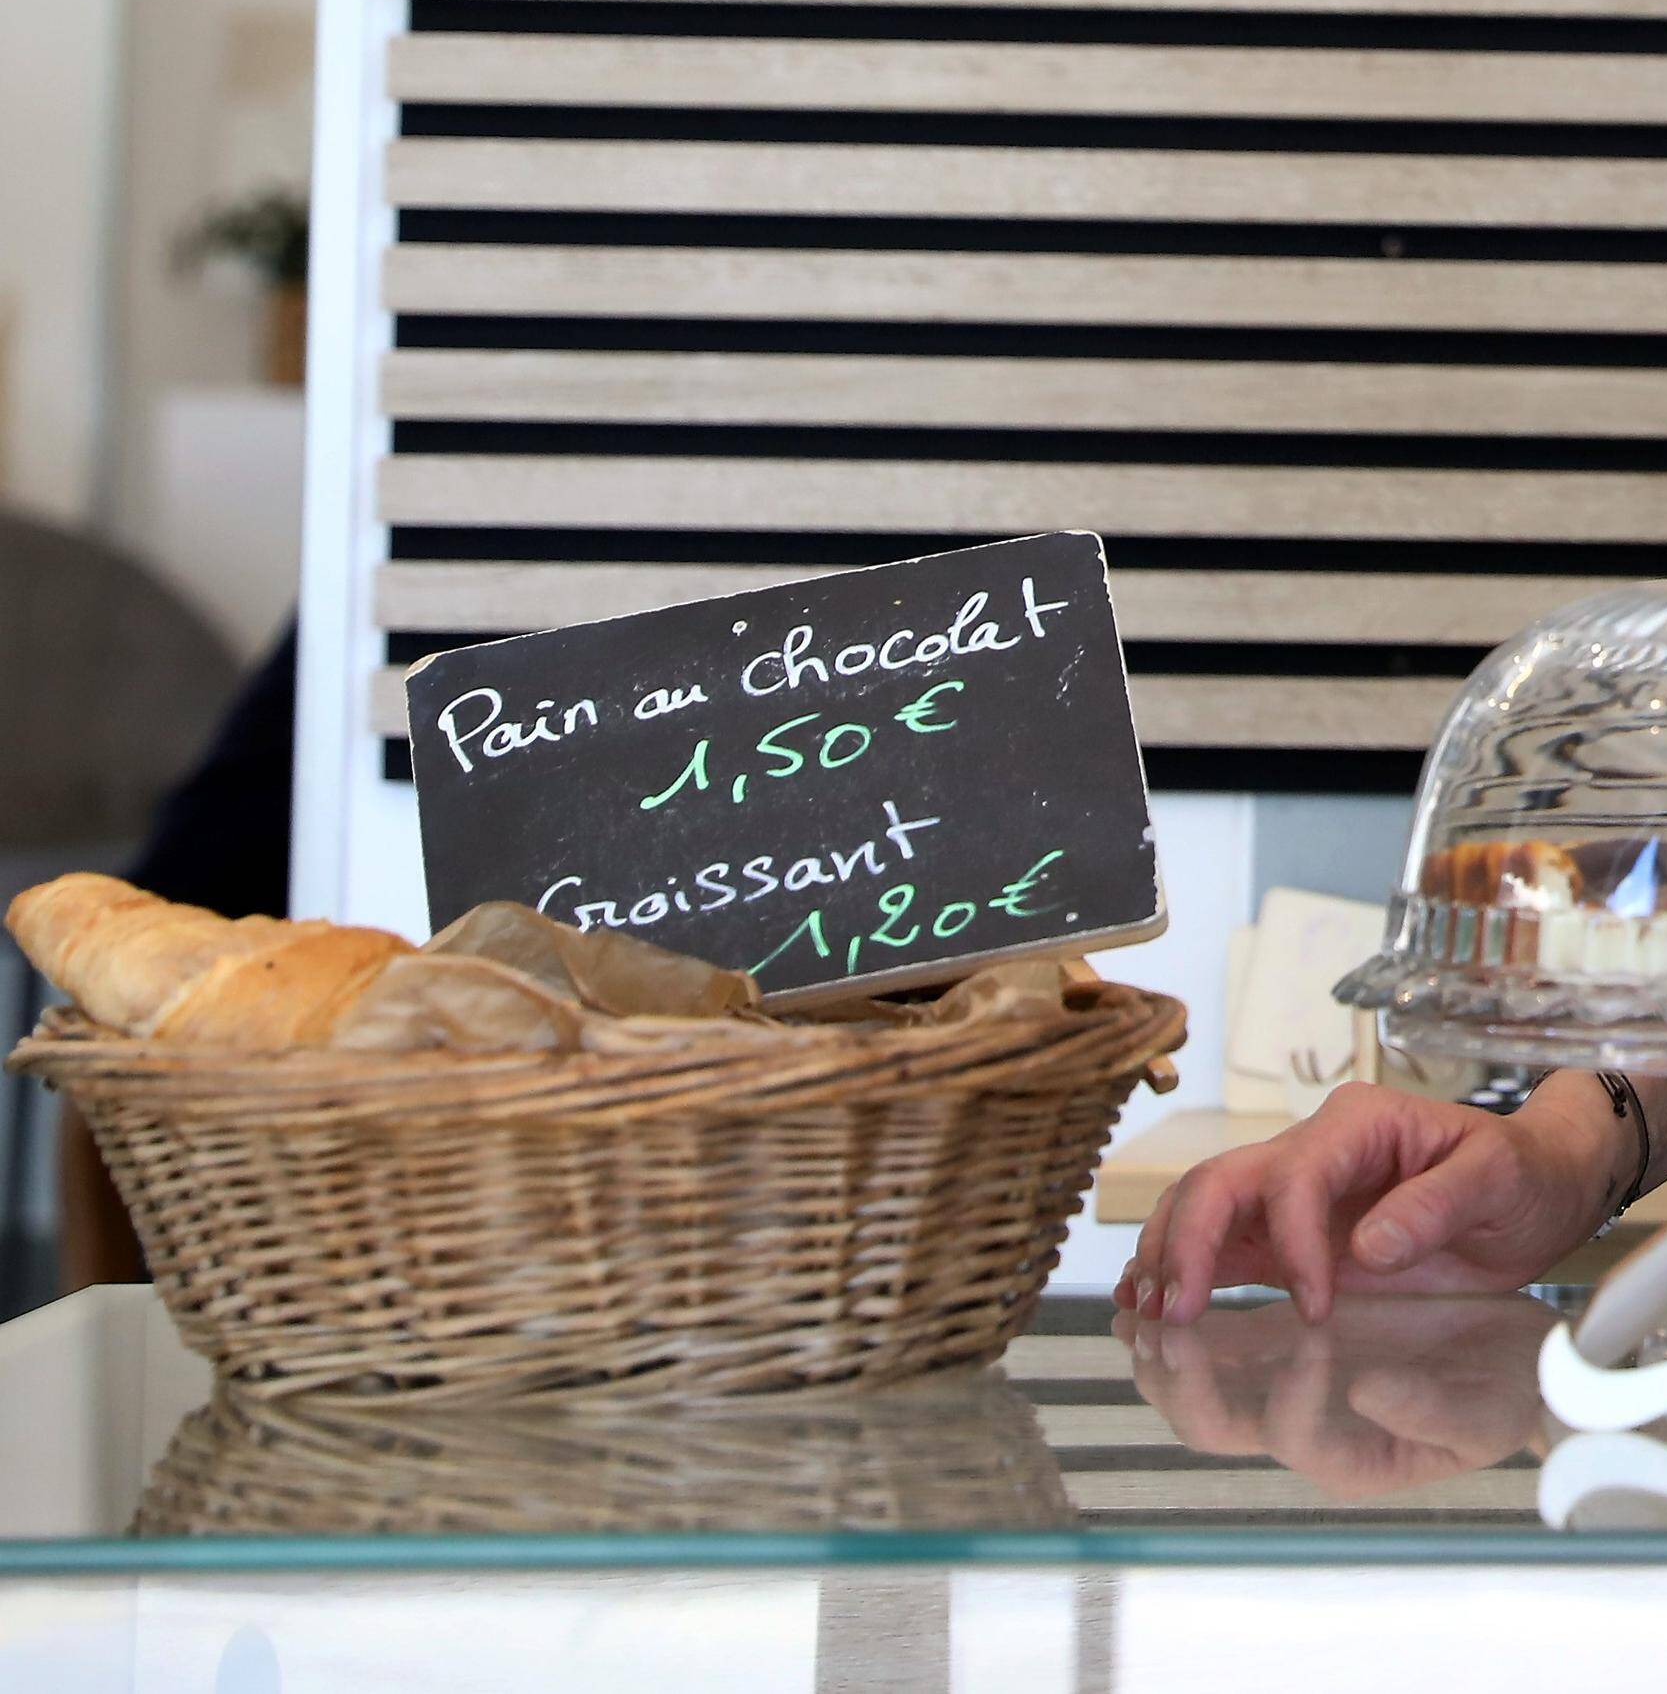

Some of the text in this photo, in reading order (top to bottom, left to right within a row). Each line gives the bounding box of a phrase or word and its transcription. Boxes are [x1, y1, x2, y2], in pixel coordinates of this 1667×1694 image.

[437, 577, 1070, 774] Pain au chocolat
[537, 800, 942, 932] Croissant
